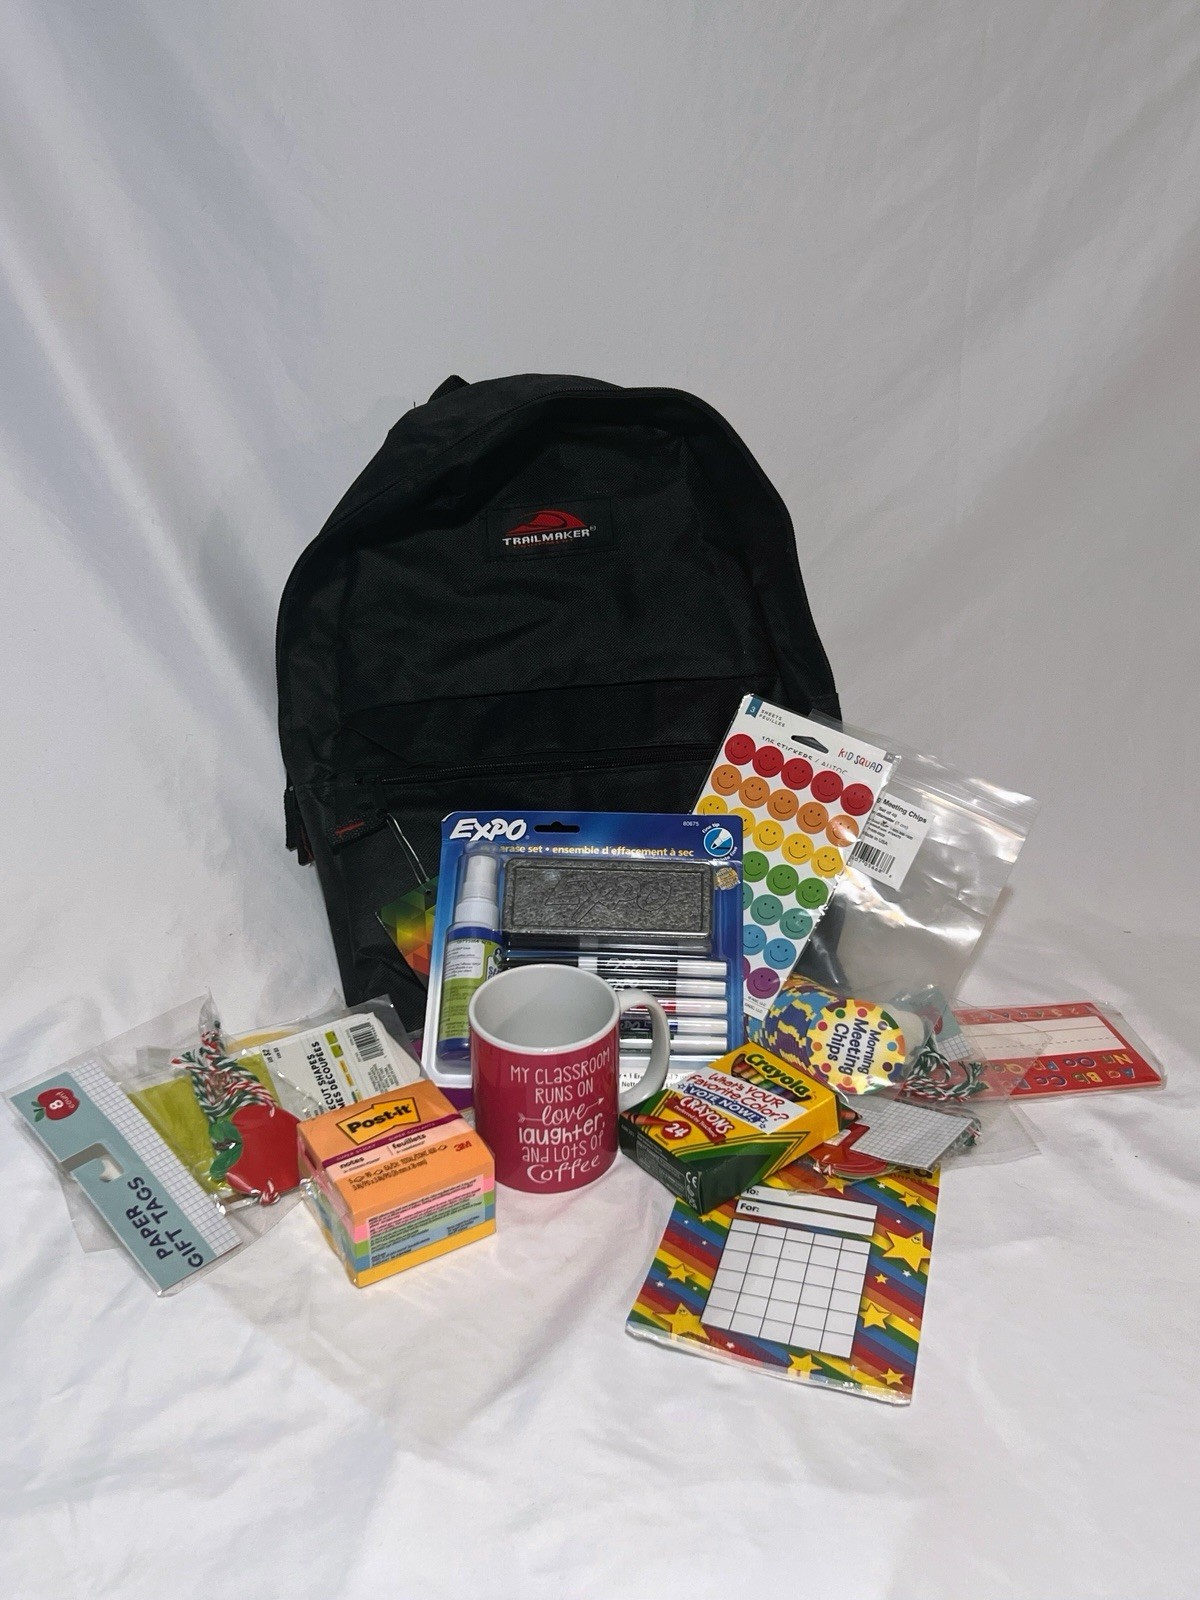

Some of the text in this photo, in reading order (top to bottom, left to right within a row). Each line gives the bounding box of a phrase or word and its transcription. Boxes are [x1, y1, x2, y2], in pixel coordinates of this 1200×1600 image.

[502, 529, 590, 546] TRAILMAKER
[749, 705, 756, 714] 3
[759, 714, 786, 728] FEUILLES
[761, 709, 782, 721] SHEETS
[837, 747, 883, 774] KID SQUAD
[883, 798, 927, 824] Meeting Chips
[449, 818, 527, 842] EXPO
[528, 844, 543, 853] set
[552, 845, 600, 855] ensemble
[669, 847, 676, 857] à
[678, 849, 694, 857] sec
[825, 1022, 850, 1062] Chips
[837, 1018, 869, 1076] Meeting
[858, 1029, 882, 1075] Morning
[305, 1052, 325, 1087] SHAPES
[510, 1065, 530, 1084] MY
[745, 1053, 812, 1098] Crayola
[320, 1085, 336, 1111] ECUT
[535, 1077, 594, 1104] RUNS ON
[687, 1074, 742, 1100] Favorite
[740, 1097, 790, 1121] Color?
[708, 1072, 745, 1091] What's
[743, 1086, 786, 1109] YOUR
[49, 1099, 65, 1111] 8
[541, 1103, 589, 1126] love
[679, 1095, 735, 1135] CRAYONS
[687, 1086, 757, 1123] VOTE NOW!
[346, 1103, 412, 1134] Post-it
[664, 1121, 690, 1139] 24
[392, 1133, 426, 1150] feuillets
[454, 1140, 472, 1152] 3M
[339, 1156, 365, 1170] notes
[740, 1202, 761, 1213] For:
[124, 1205, 174, 1260] PAPER
[127, 1176, 204, 1267] GIFT TAGS
